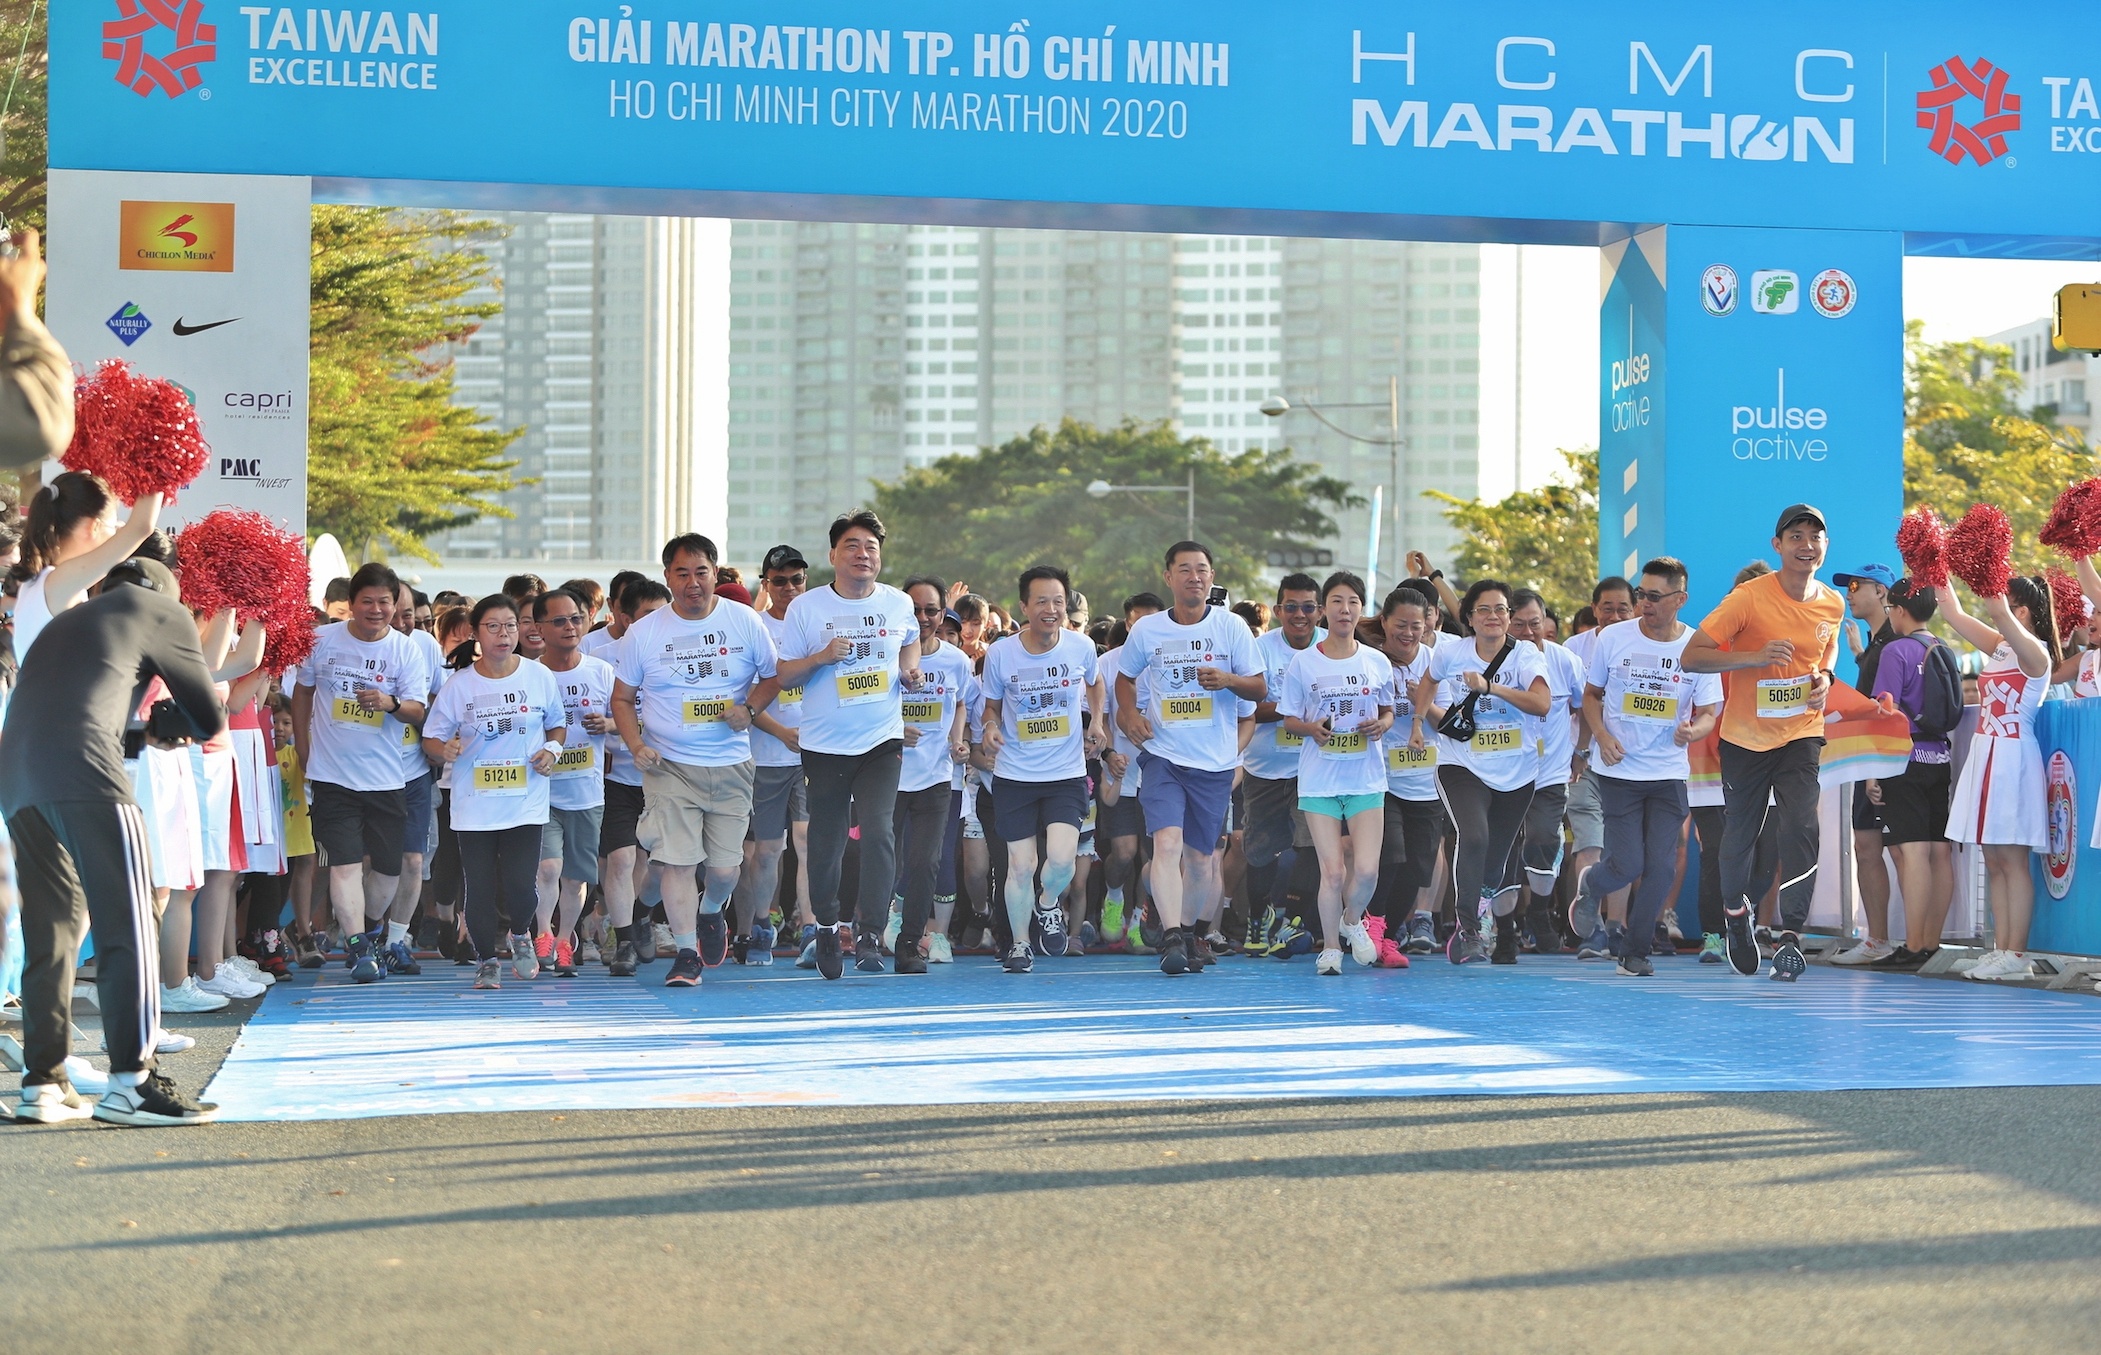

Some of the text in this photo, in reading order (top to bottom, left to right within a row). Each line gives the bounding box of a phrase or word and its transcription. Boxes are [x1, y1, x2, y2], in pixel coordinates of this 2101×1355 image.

[240, 7, 437, 55] TAIWAN
[569, 5, 1228, 86] GIẢI MARATHON TP. HỒ CHÍ MINH
[250, 58, 436, 89] EXCELLENCE
[611, 80, 1186, 138] HO CHI MINH CITY MARATHON 2020
[1353, 99, 1853, 163] MARATHON
[184, 250, 214, 260] MEDIA
[110, 319, 148, 328] NATURALLY
[120, 328, 137, 336] PLUS
[1612, 304, 1650, 399] pulse
[225, 390, 291, 411] capri
[1733, 368, 1827, 434] pulse
[1612, 390, 1650, 432] active
[1733, 432, 1827, 461] active
[221, 459, 260, 476] PMC
[256, 478, 292, 488] INVEST
[863, 616, 874, 626] 10
[704, 634, 715, 645] 10
[1191, 641, 1201, 650] 10
[366, 659, 375, 669] 10
[1662, 658, 1672, 668] 10
[688, 664, 694, 674] 5
[1047, 667, 1057, 677] 10
[1173, 669, 1179, 679] 5
[848, 675, 879, 690] 50005
[924, 672, 934, 682] 10
[1346, 676, 1357, 685] 10
[342, 681, 348, 692] 5
[567, 685, 578, 695] 10
[504, 693, 516, 703] 10
[1770, 687, 1801, 702] 50530
[1031, 696, 1036, 705] 5
[1634, 697, 1665, 712] 50926
[694, 703, 724, 716] 50009
[903, 705, 932, 716] 50001
[1171, 701, 1201, 714] 50004
[1330, 702, 1336, 712] 5
[487, 721, 493, 732] 5
[1028, 720, 1058, 734] 50003
[1329, 735, 1358, 747] 51219
[1479, 732, 1510, 745] 51216
[1399, 750, 1427, 762] 51082
[485, 769, 517, 782] 51214
